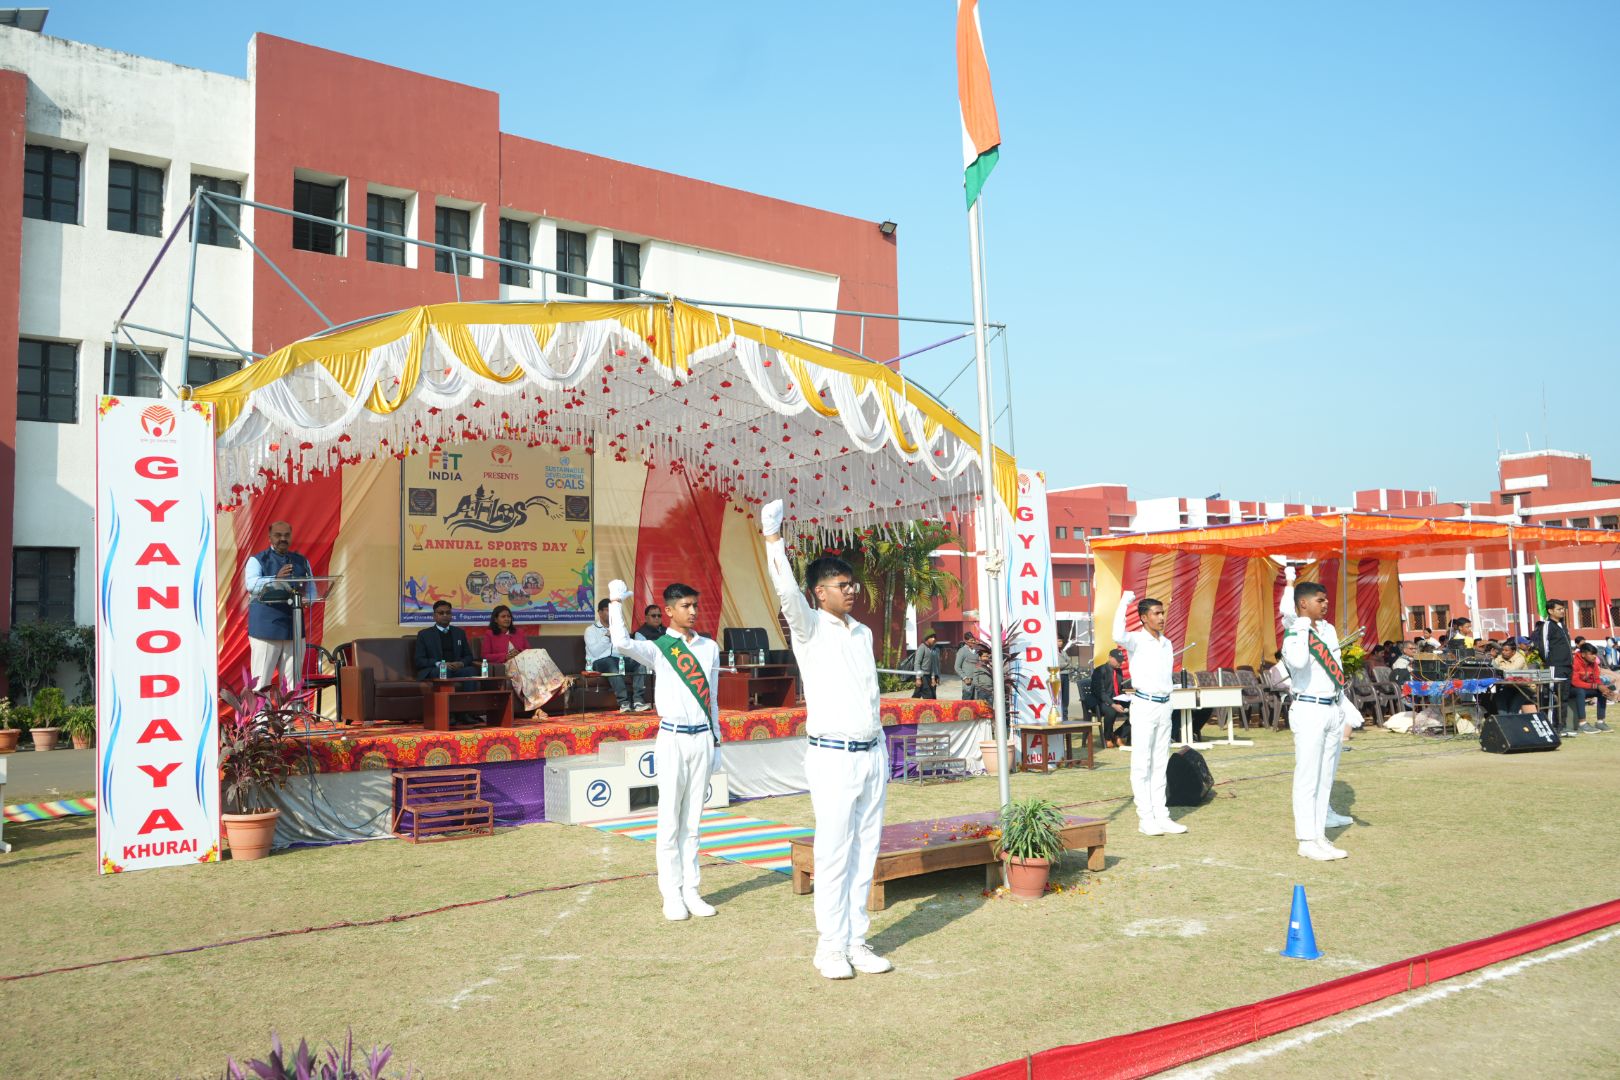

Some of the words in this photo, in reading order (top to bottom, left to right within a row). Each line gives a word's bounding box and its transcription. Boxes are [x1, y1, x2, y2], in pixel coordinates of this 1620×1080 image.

[428, 471, 464, 482] INDIA
[483, 472, 520, 481] PRESENTS
[545, 478, 585, 490] GOALS
[425, 539, 483, 551] ANNUAL
[487, 540, 537, 552] SPORTS
[542, 542, 568, 552] DAY
[473, 557, 528, 569] 2024-25
[135, 456, 184, 836] GYANODAYA
[643, 754, 655, 775] 1
[591, 782, 607, 802] 2
[123, 839, 198, 860] KHURAI
